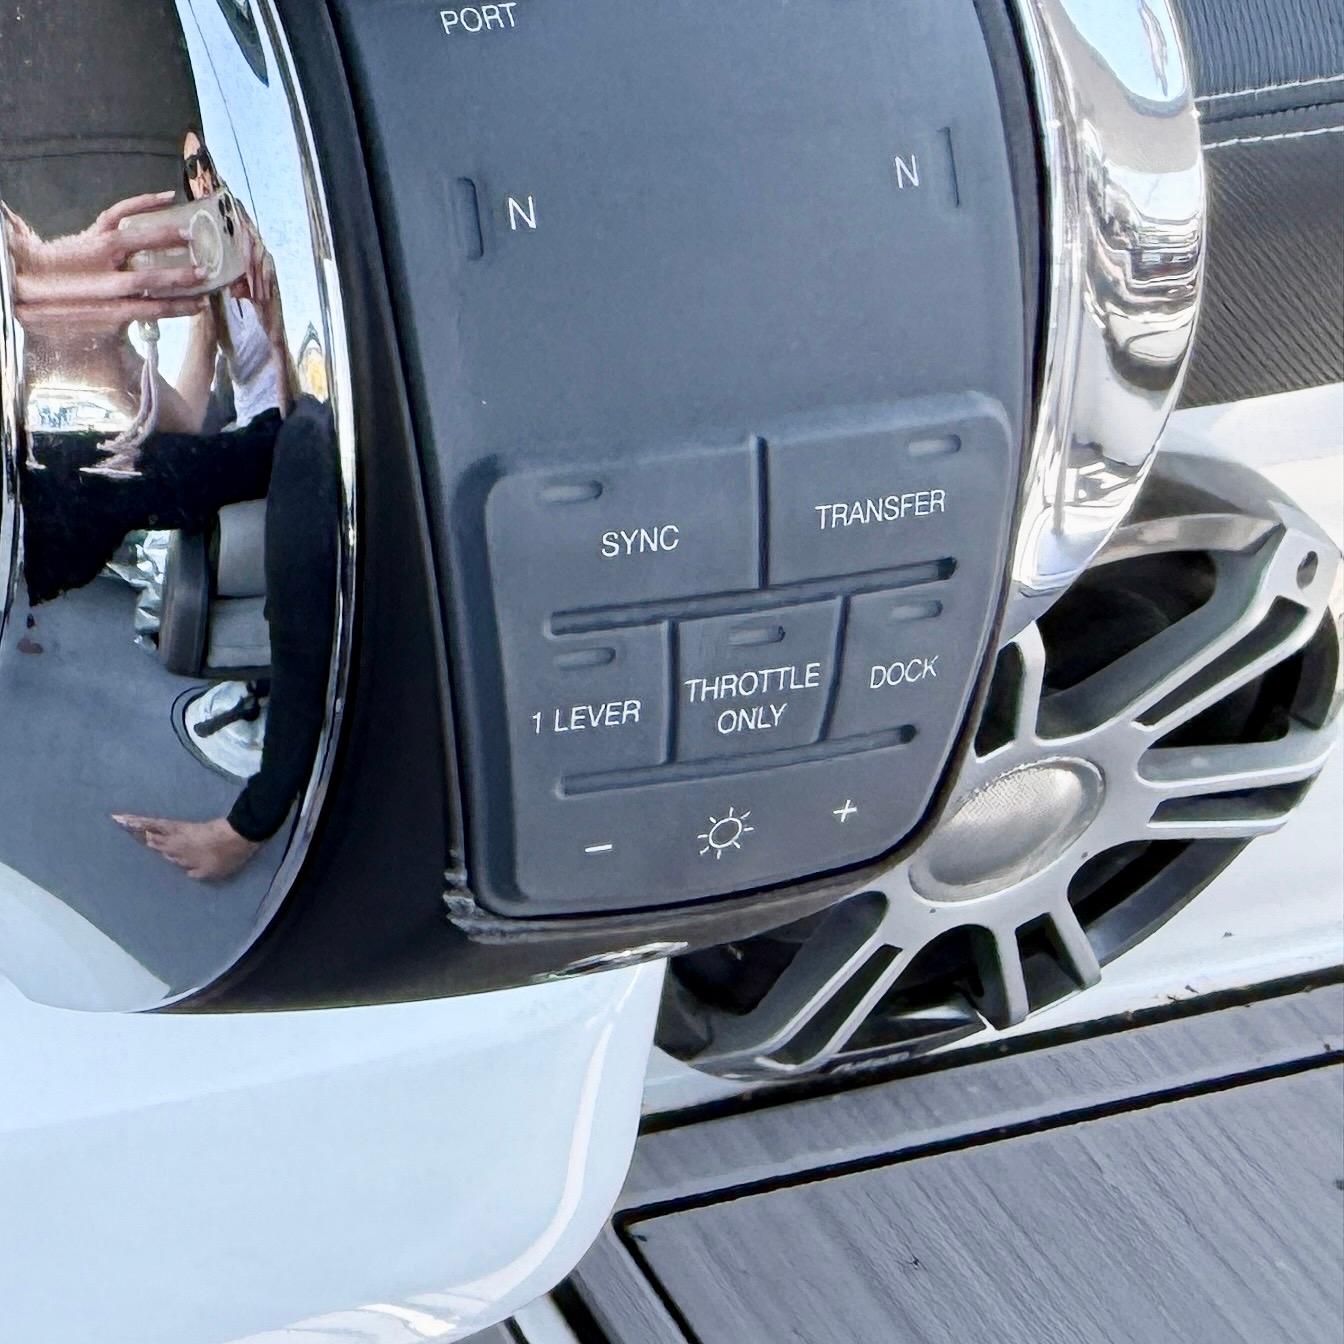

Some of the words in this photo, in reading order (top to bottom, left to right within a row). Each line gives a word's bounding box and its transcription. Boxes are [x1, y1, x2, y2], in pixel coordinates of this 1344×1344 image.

[440, 2, 516, 36] PORT
[895, 156, 919, 189] N
[508, 196, 537, 230] N
[815, 489, 946, 531] TRANSFER
[600, 524, 680, 558] SYNC
[684, 663, 820, 704] THROTTLE
[869, 655, 939, 690] DOCK
[531, 711, 542, 735] 1
[553, 700, 640, 733] LEVER
[717, 703, 788, 735] ONLY
